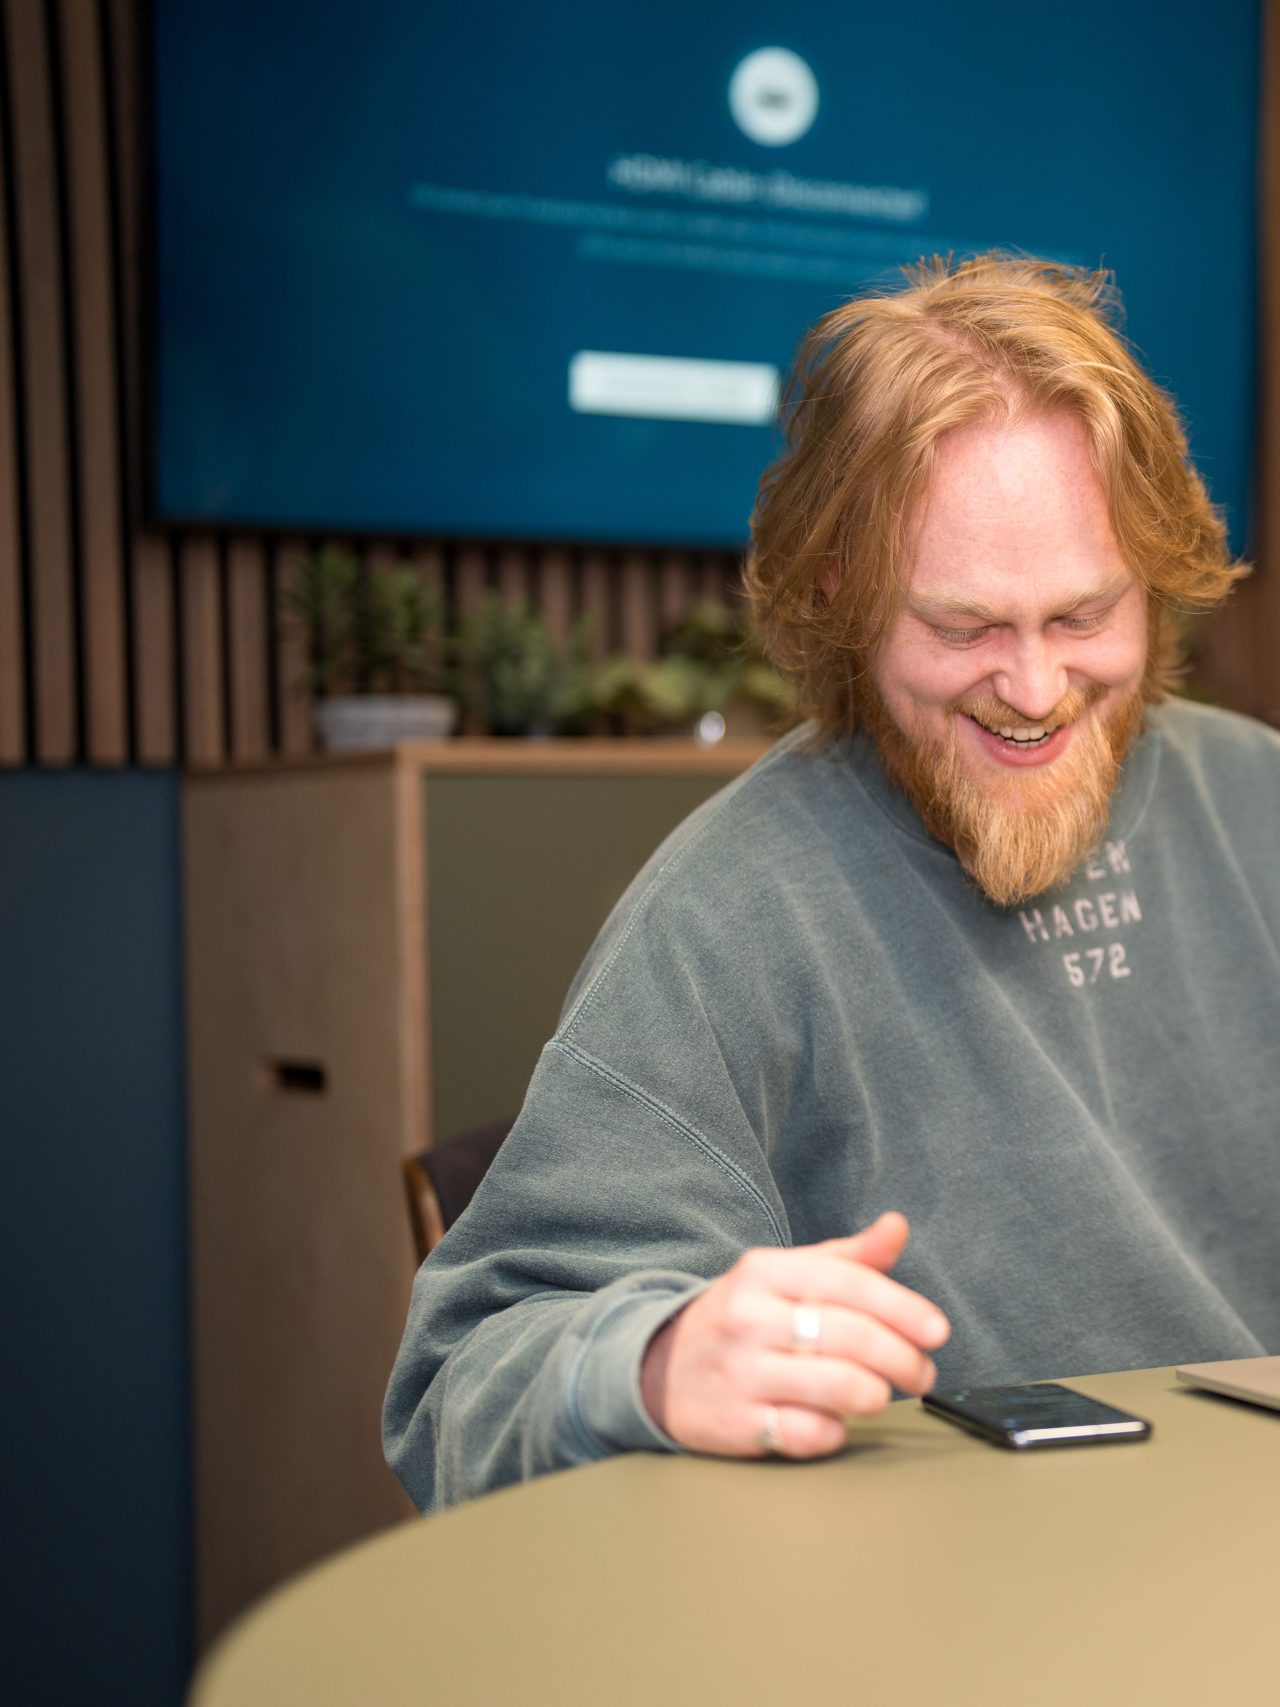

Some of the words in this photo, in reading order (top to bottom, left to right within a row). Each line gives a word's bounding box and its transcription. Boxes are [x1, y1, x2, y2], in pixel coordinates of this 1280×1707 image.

[1073, 840, 1131, 881] EN
[1018, 890, 1142, 943] HAGEN
[1062, 942, 1131, 987] 572
